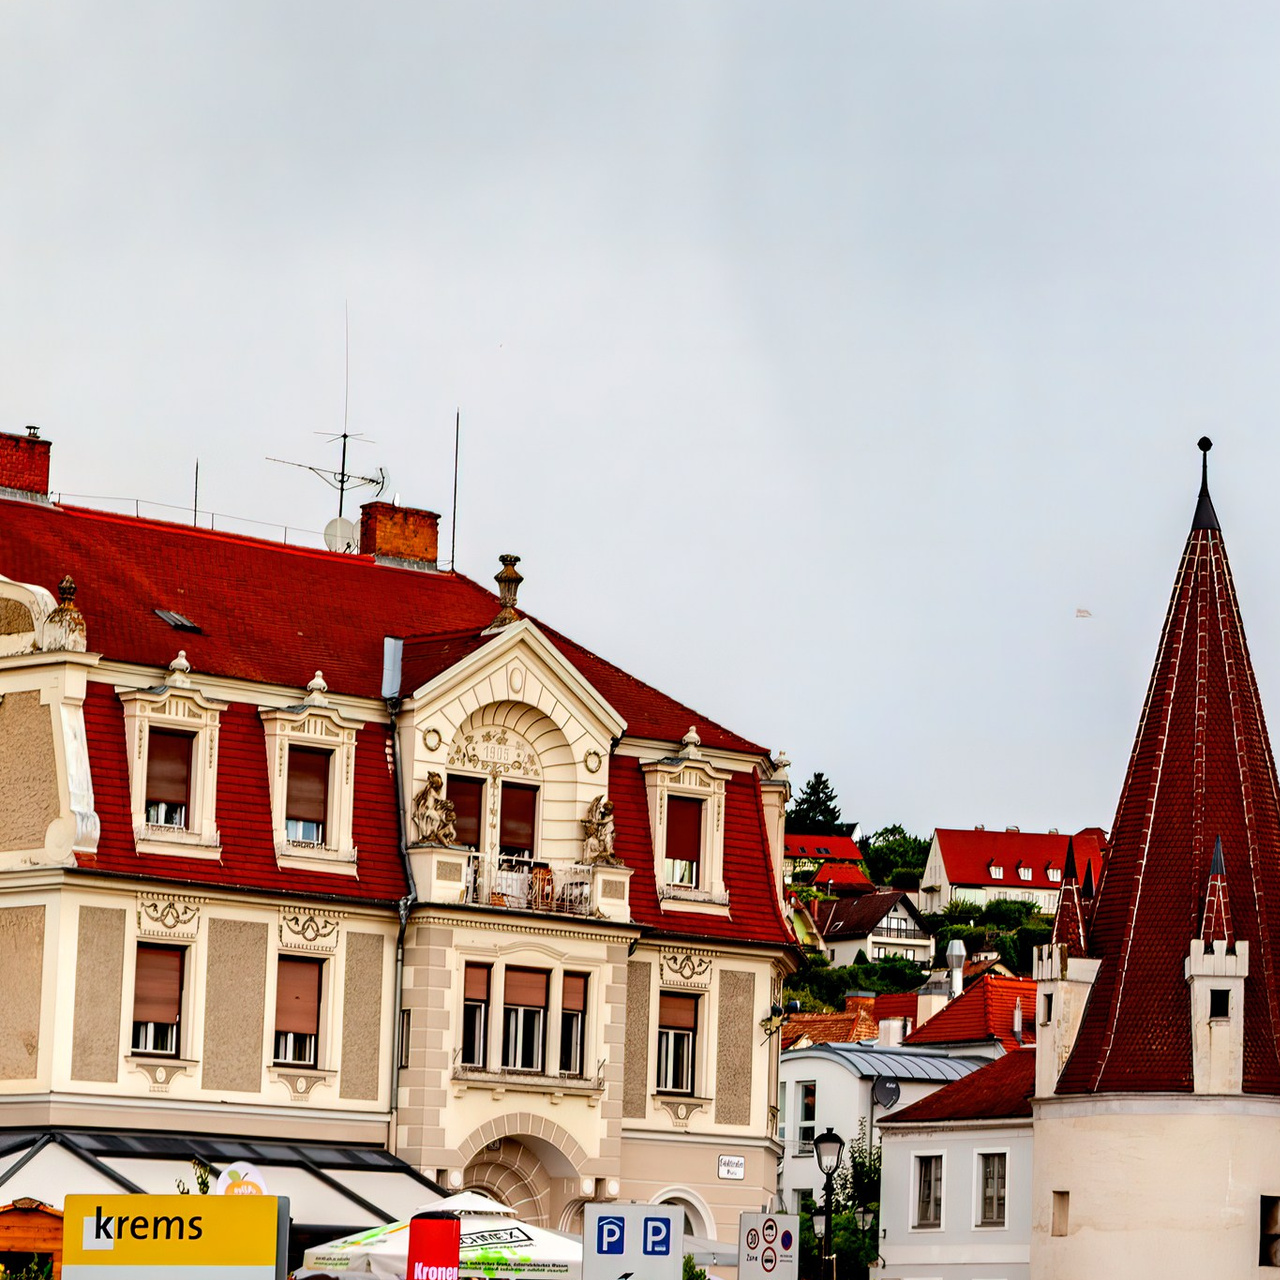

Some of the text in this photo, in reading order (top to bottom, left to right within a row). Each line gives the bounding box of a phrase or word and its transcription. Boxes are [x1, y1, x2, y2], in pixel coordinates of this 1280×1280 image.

[484, 745, 510, 761] 1905
[95, 1206, 202, 1240] krems
[646, 1221, 667, 1251] P
[603, 1224, 620, 1251] P
